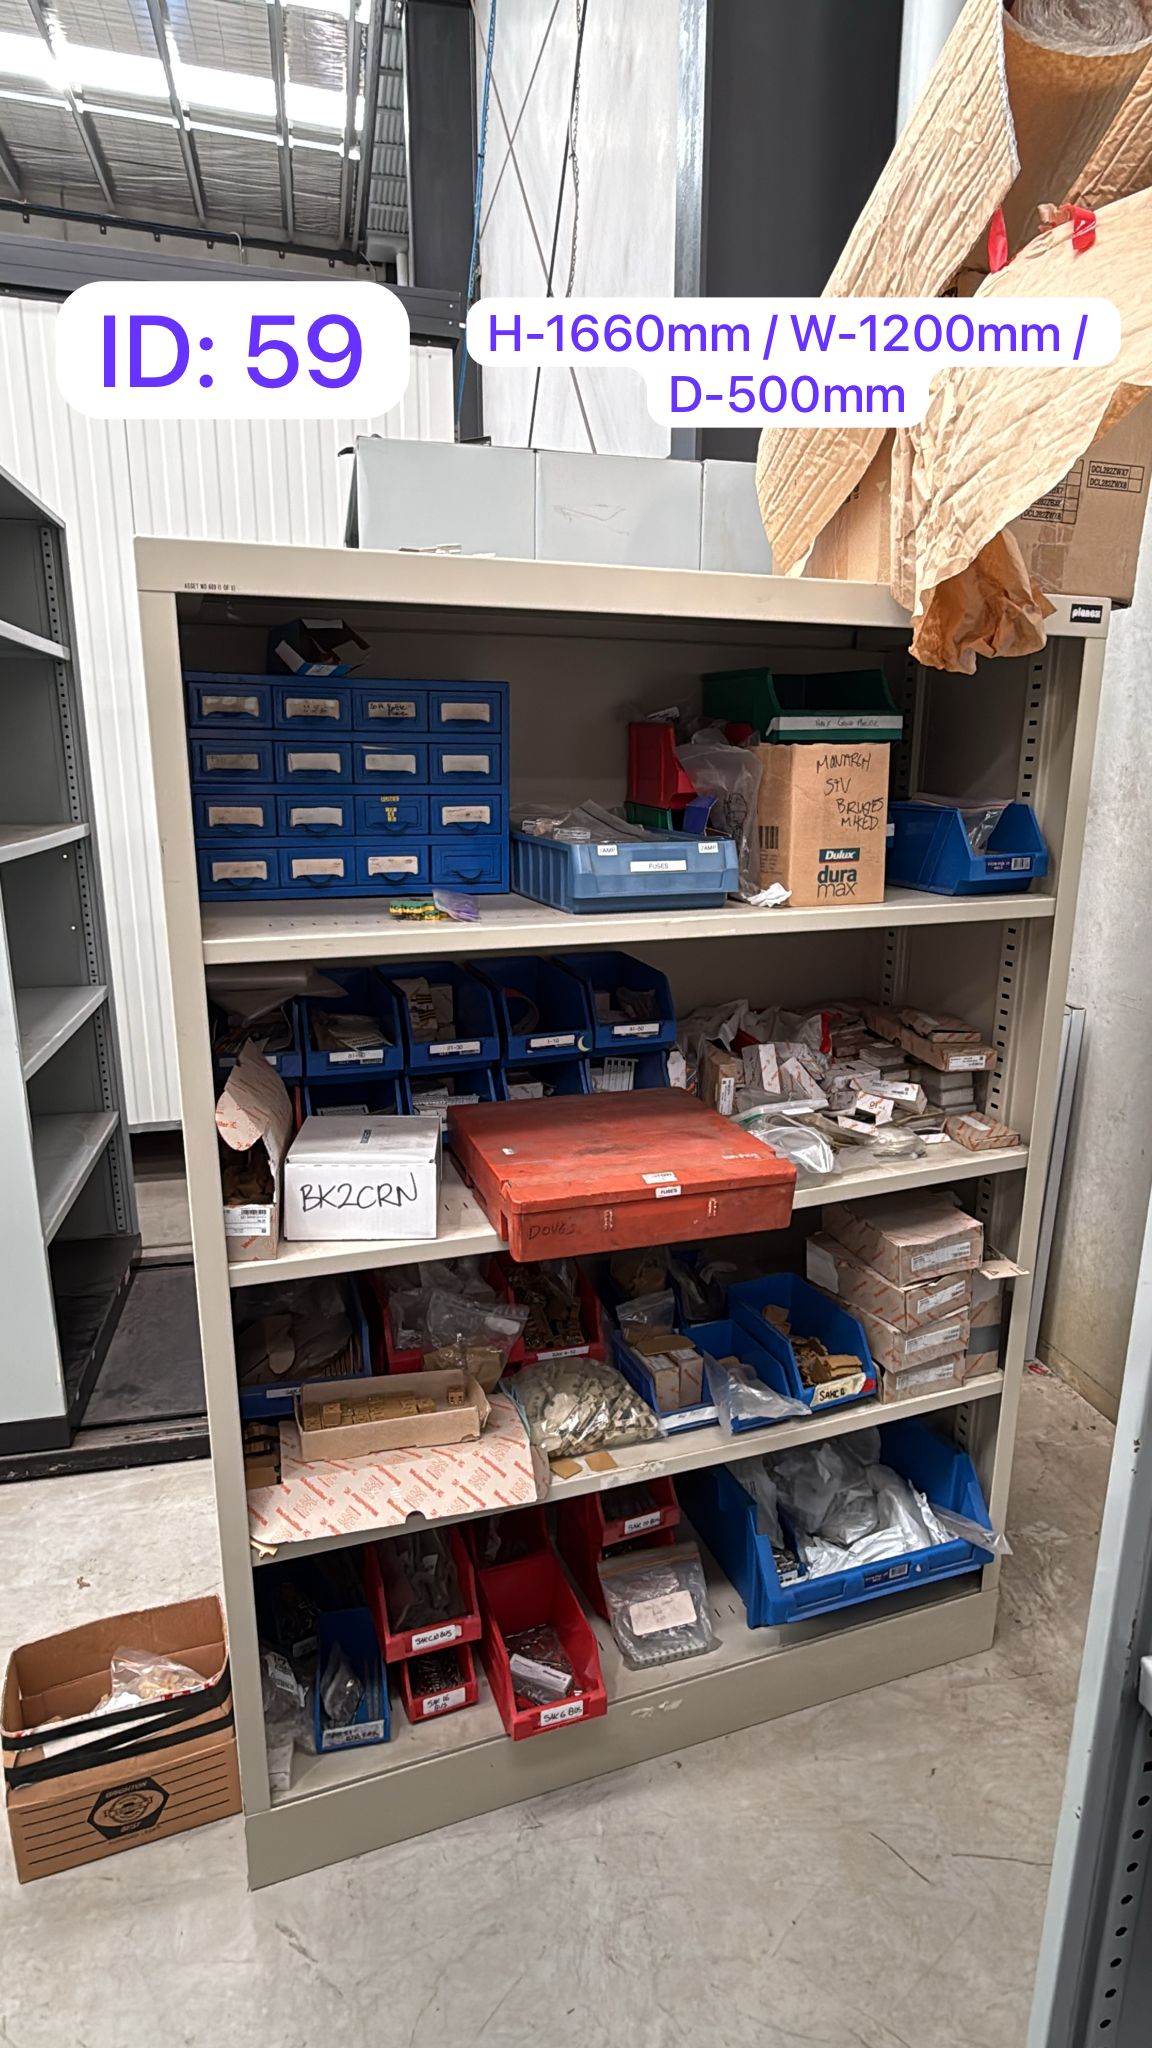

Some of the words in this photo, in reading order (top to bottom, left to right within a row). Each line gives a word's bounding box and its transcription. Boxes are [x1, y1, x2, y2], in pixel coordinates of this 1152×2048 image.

[824, 849, 857, 860] Dulux
[648, 862, 669, 870] FUSES
[817, 864, 858, 884] dura
[816, 881, 858, 898] max
[299, 1171, 418, 1213] BK2CRN
